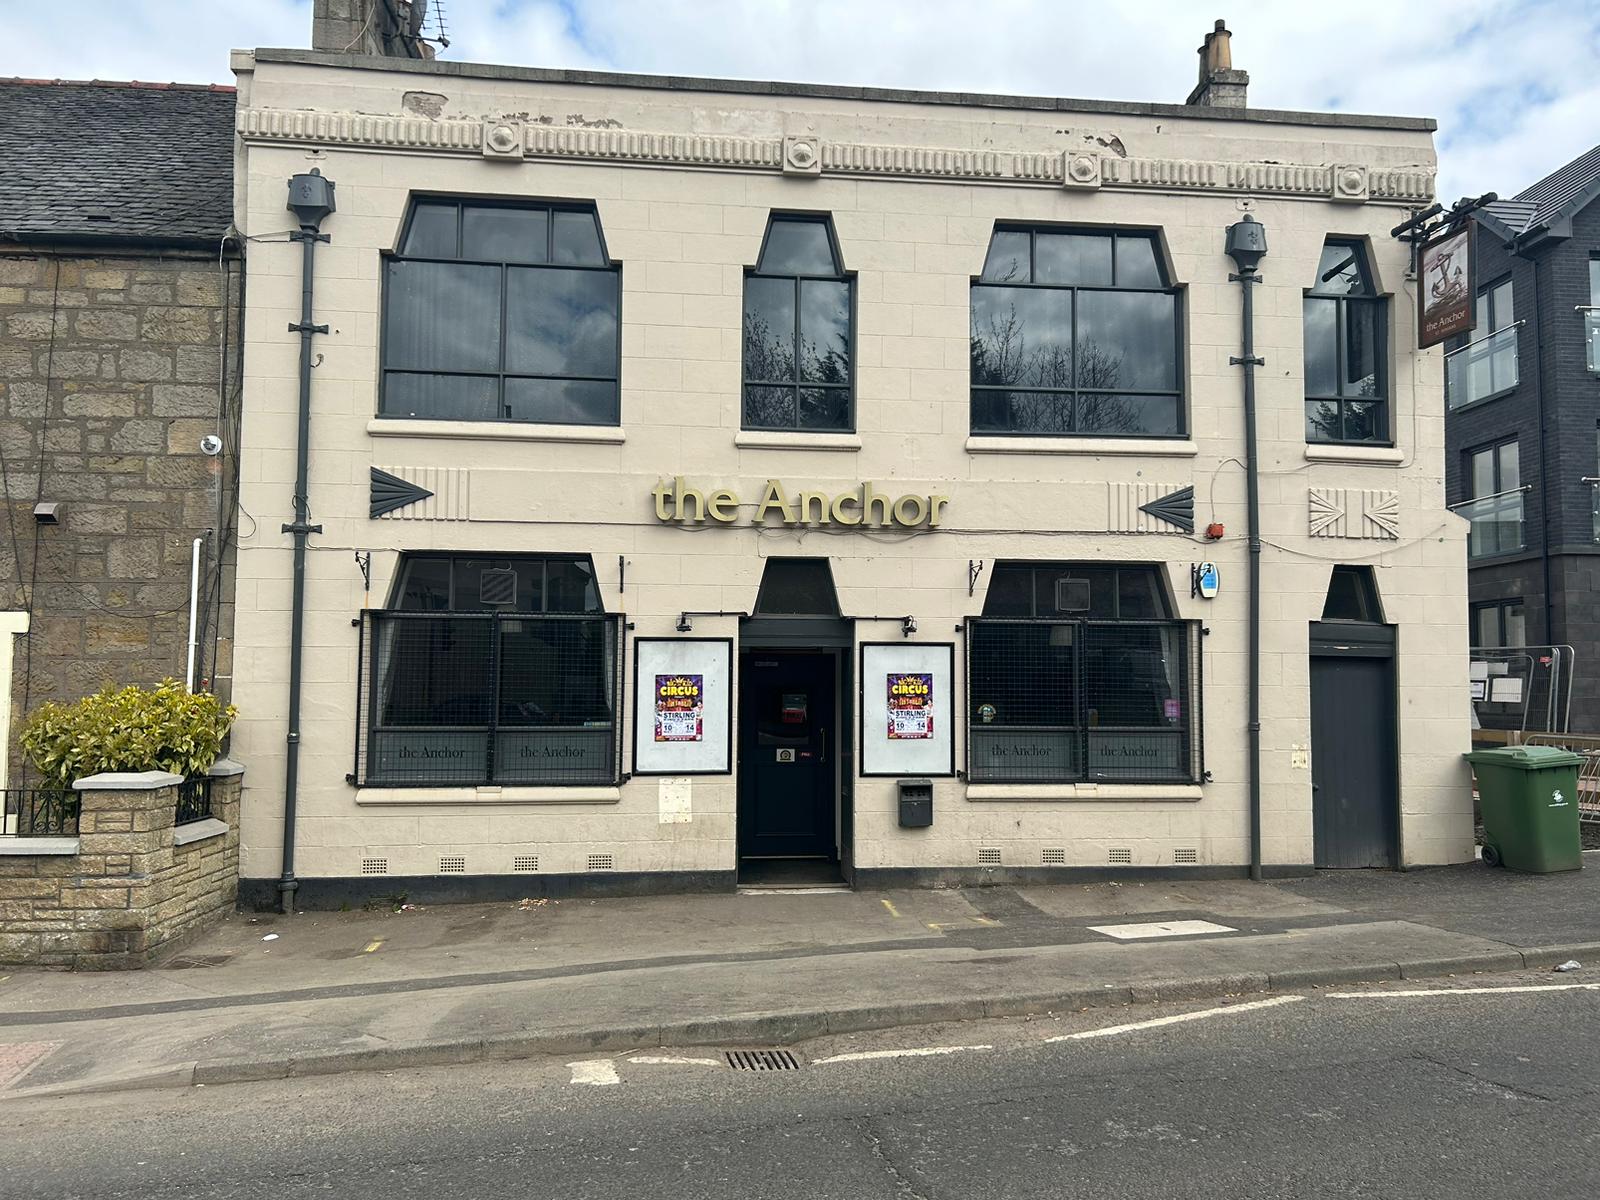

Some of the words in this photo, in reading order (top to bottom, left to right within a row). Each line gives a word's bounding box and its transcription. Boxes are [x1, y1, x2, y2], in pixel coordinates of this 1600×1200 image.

[1426, 321, 1438, 332] the
[1439, 310, 1466, 326] Anchor
[651, 476, 740, 523] the
[751, 478, 950, 527] Anchor
[660, 686, 699, 696] CIRCUS
[892, 685, 929, 694] CIRCUS
[399, 746, 418, 759] the
[421, 746, 465, 759] Anchor
[520, 745, 539, 758] the
[542, 745, 585, 758] Anchor
[991, 744, 1008, 756] the
[1011, 744, 1051, 757] Anchor
[1100, 745, 1117, 757] the
[1119, 745, 1160, 757] Anchor
